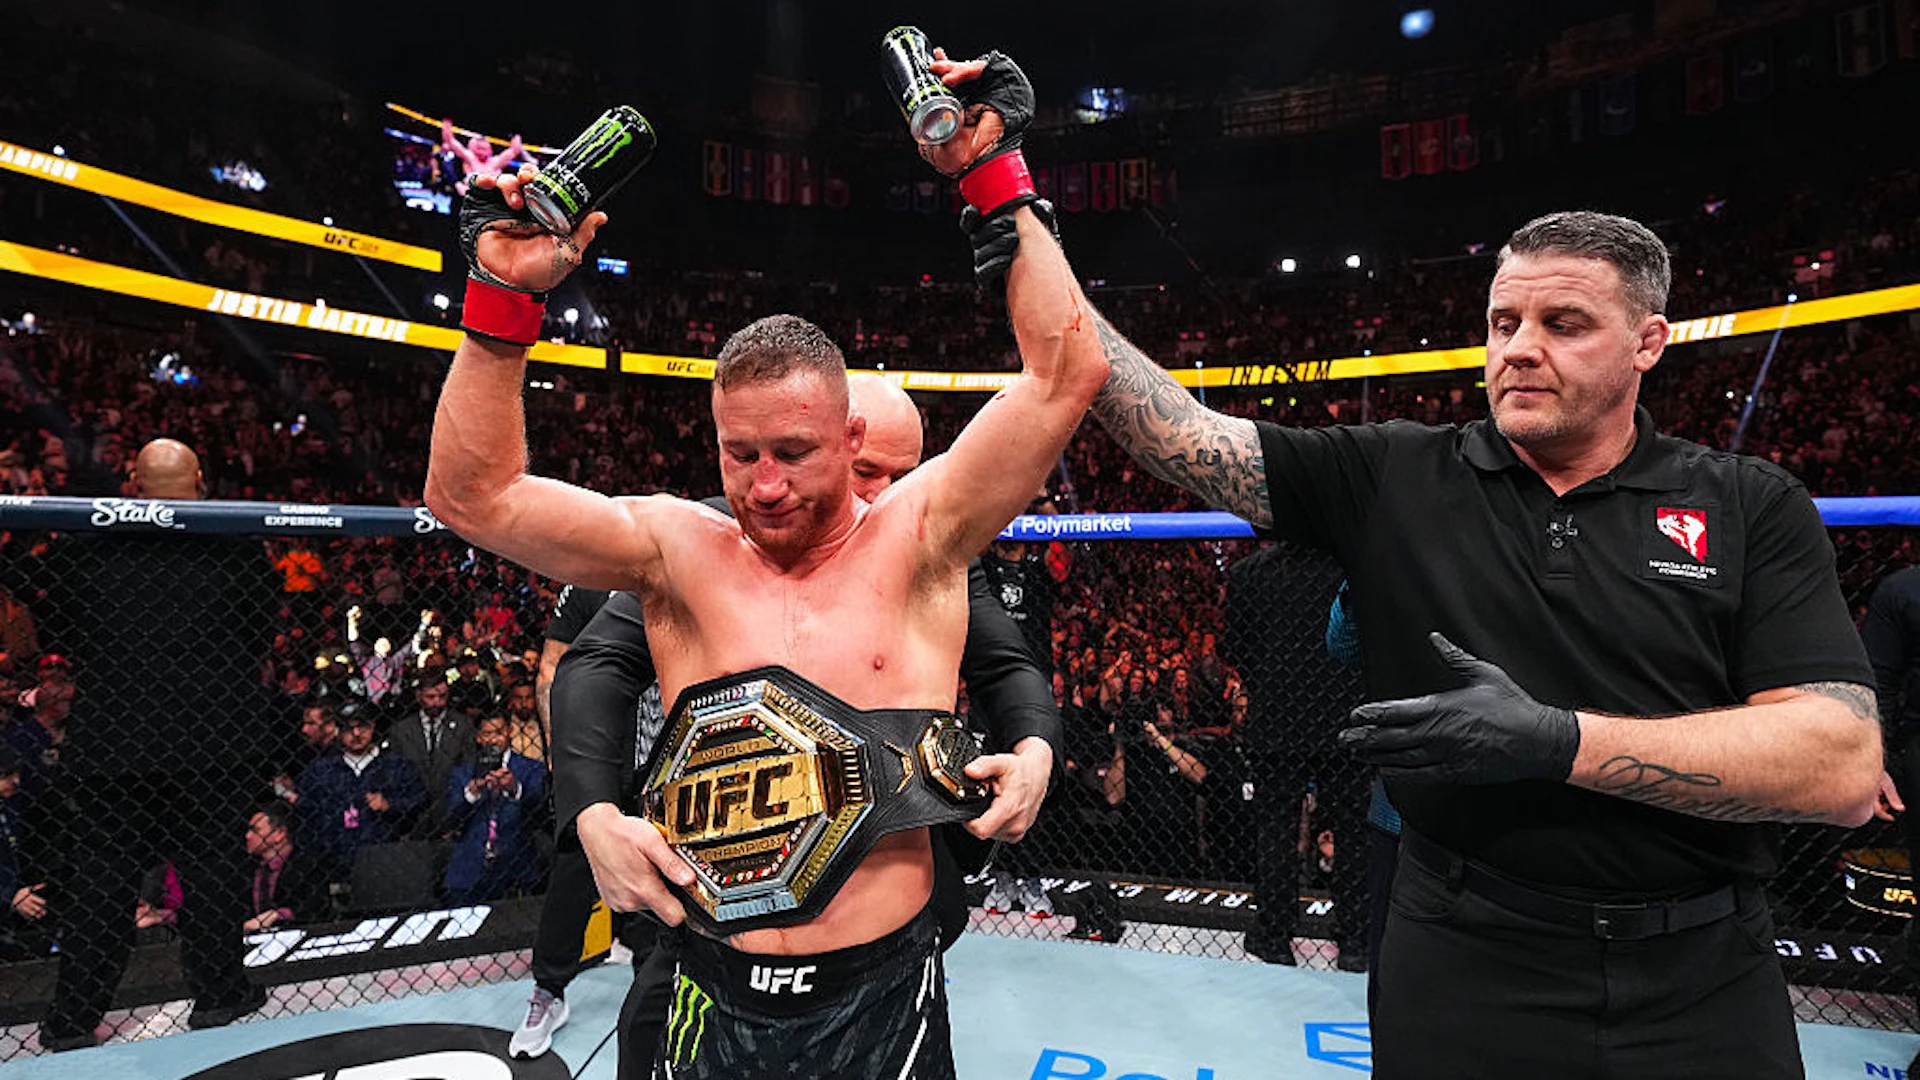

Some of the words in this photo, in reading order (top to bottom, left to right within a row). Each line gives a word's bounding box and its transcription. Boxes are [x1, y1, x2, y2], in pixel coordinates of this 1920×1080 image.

[0, 143, 78, 181] AMPION
[208, 289, 302, 324] JUSTIN
[91, 498, 175, 528] Stake
[264, 515, 343, 528] EXPERIENCE
[1020, 515, 1132, 537] Polymarket
[701, 741, 760, 761] WORLD
[676, 761, 793, 833] UFC
[704, 838, 781, 861] CHAMPION
[750, 965, 817, 994] UFC
